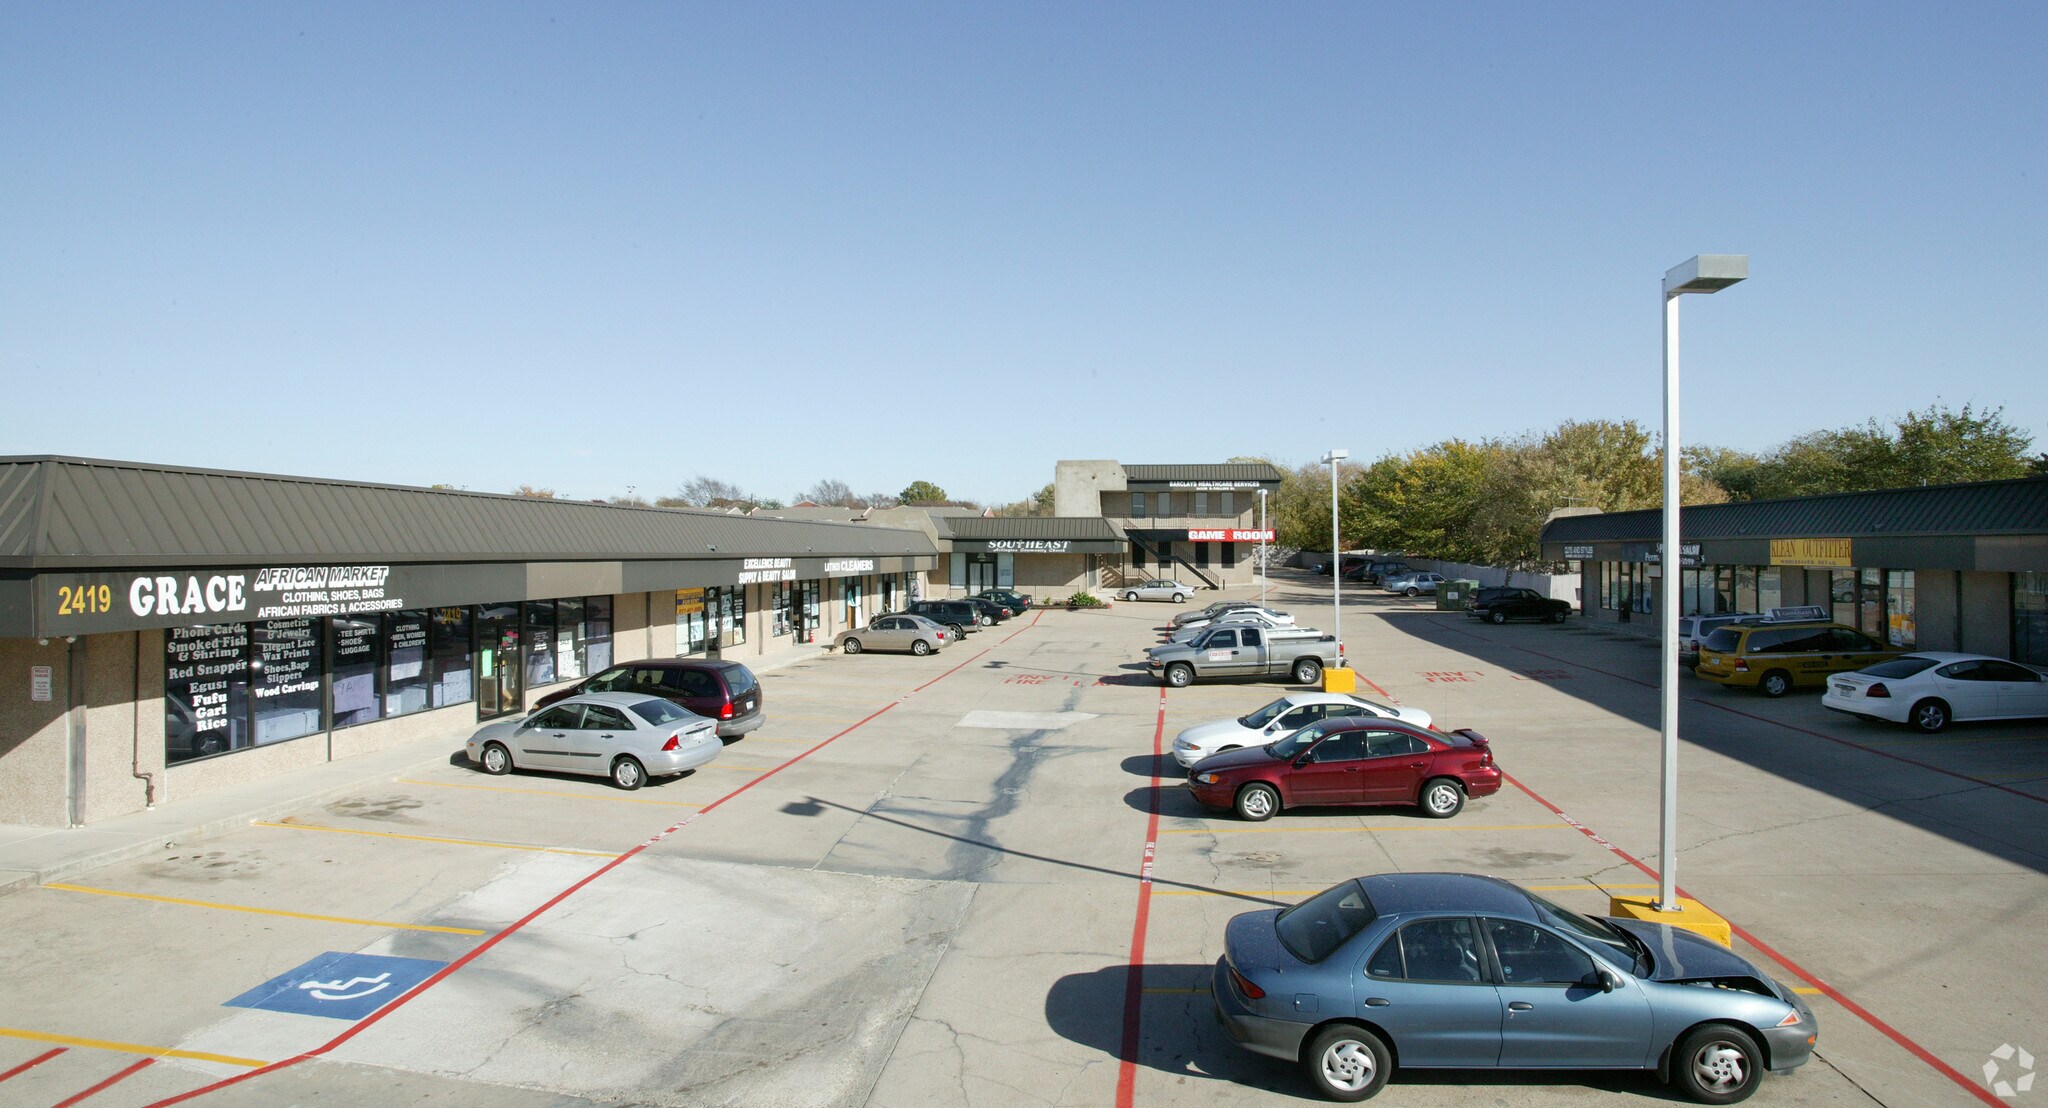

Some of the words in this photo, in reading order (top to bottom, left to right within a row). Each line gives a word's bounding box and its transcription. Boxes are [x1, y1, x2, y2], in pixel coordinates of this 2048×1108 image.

[1188, 530, 1225, 540] GAME
[1232, 530, 1274, 540] ROOM
[988, 540, 1071, 549] SOUTHEAST
[1772, 540, 1796, 557] KLEAN
[1802, 540, 1851, 558] OUTFITTER
[744, 558, 774, 570] EXCELLENCE
[774, 558, 792, 568] BEAUTY
[841, 560, 874, 571] CLEANERS
[254, 567, 328, 591] AFRICAN
[328, 566, 389, 588] MARKET
[739, 571, 757, 584] SUPPLY
[757, 571, 762, 582] &
[762, 570, 781, 581] BEAUTY
[782, 569, 796, 580] SALON
[58, 584, 111, 615] 2419
[129, 575, 247, 617] GRACE
[282, 592, 329, 604] CLOTHING,
[331, 590, 361, 601] SHOES,
[362, 589, 385, 599] BAGS
[257, 606, 300, 618] AFRICAN
[301, 604, 339, 615] FABRICS
[340, 603, 347, 613] &
[348, 599, 403, 612] ACCESSORIES
[440, 608, 461, 624] 2419
[173, 627, 211, 639] Phone
[214, 623, 247, 635] Cards
[267, 618, 310, 630] Cosmetics
[396, 624, 420, 632] CLOTHING
[267, 630, 276, 640] &
[277, 627, 311, 639] Jewelry
[354, 627, 376, 636] SHIRTS
[406, 631, 426, 639] WOMEN
[168, 638, 219, 653] Smoked
[222, 635, 248, 648] Fish
[262, 641, 295, 653] Elegant
[297, 638, 315, 648] Lace
[341, 637, 362, 646] SHOES
[560, 638, 570, 646] SALE
[178, 652, 189, 661] &
[192, 648, 239, 660] Shrimp
[262, 651, 281, 661] Wax
[283, 649, 310, 659] Prints
[341, 645, 370, 655] LUGGAGE
[169, 666, 194, 679] Red
[197, 661, 248, 675] Snapper
[266, 671, 302, 683] Slippers
[189, 680, 228, 694] Egusi
[255, 686, 280, 698] Wood
[281, 681, 319, 693] Carvings
[192, 693, 228, 707] Fufu
[196, 704, 228, 719] Gari
[196, 718, 228, 732] Rice
